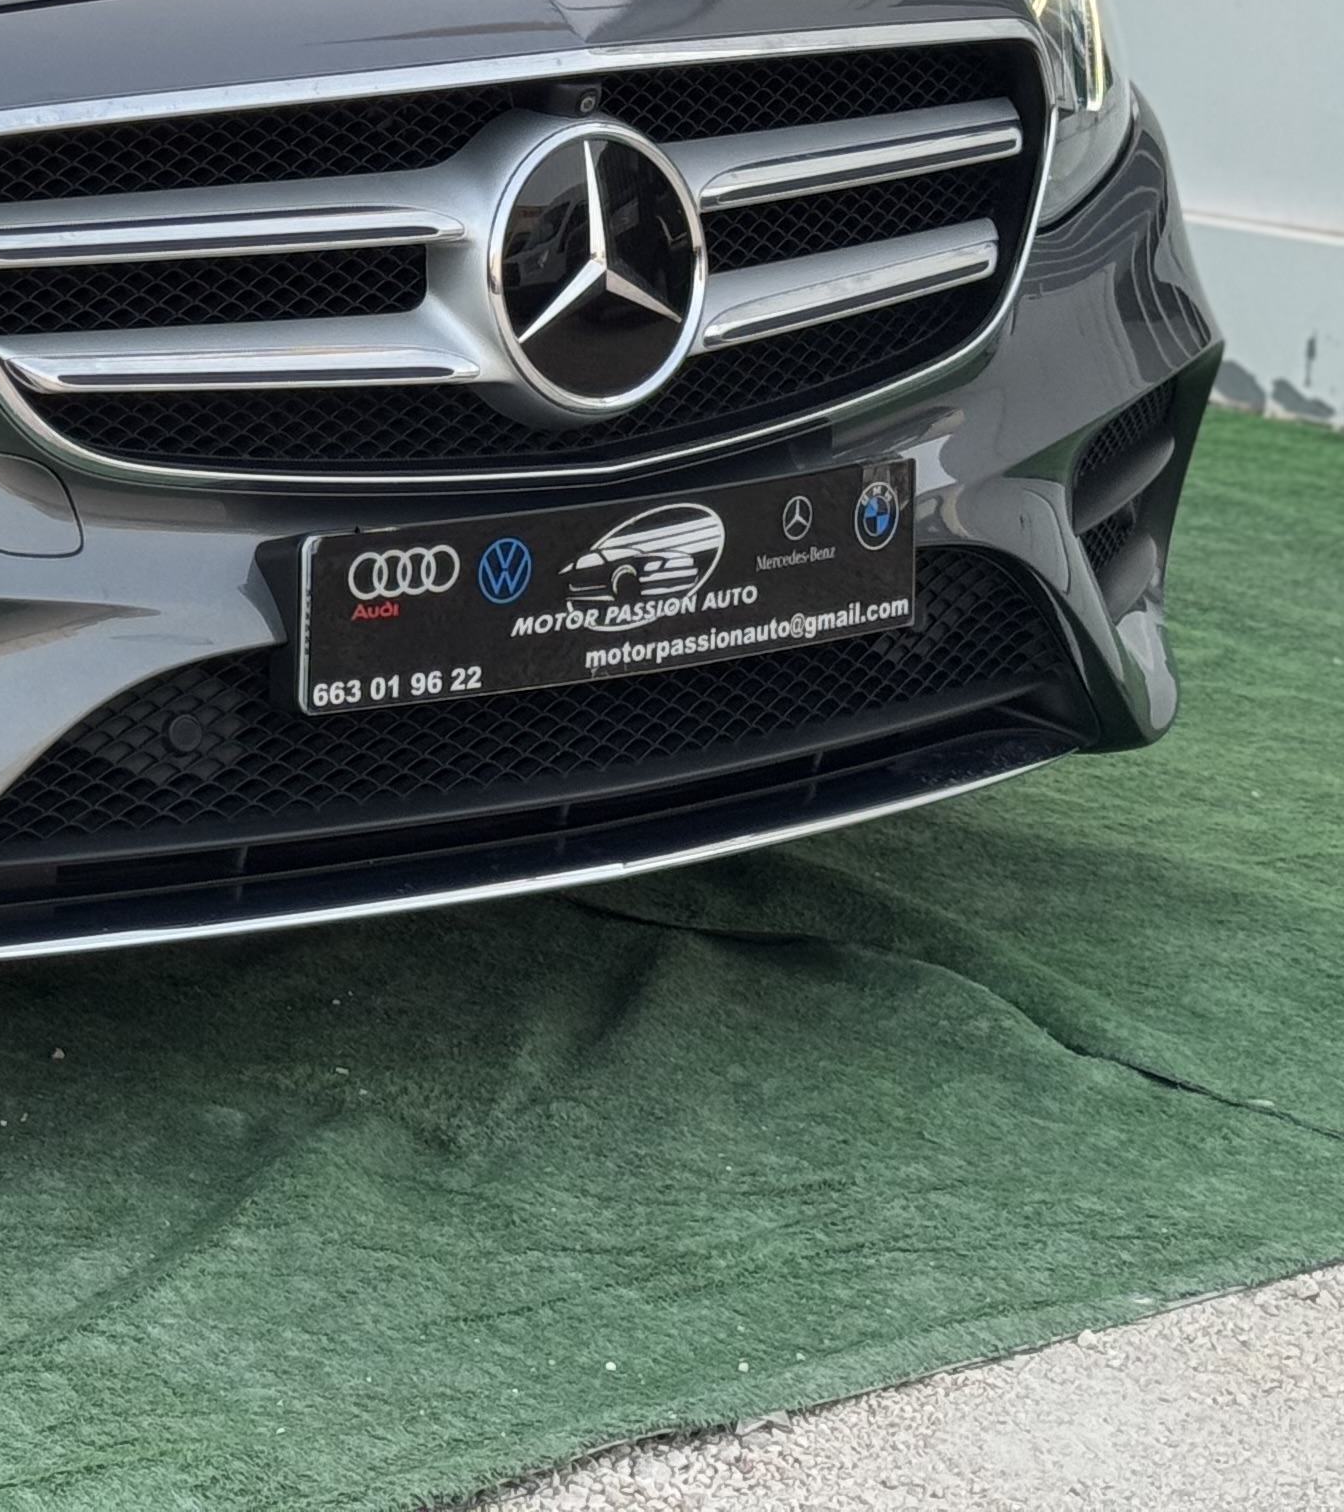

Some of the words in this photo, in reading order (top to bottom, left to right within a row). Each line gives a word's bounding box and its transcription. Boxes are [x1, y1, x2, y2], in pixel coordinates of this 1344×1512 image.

[755, 546, 837, 572] Mercedes-Benz
[350, 601, 400, 621] Audi
[510, 608, 599, 638] MOTOR
[604, 594, 697, 625] PASSION
[701, 585, 759, 611] AUTO
[584, 597, 910, 668] motorpassionauto@gmail.com
[312, 679, 362, 707] 663
[370, 674, 400, 701] 01
[411, 670, 443, 696] 96
[449, 665, 482, 692] 22
